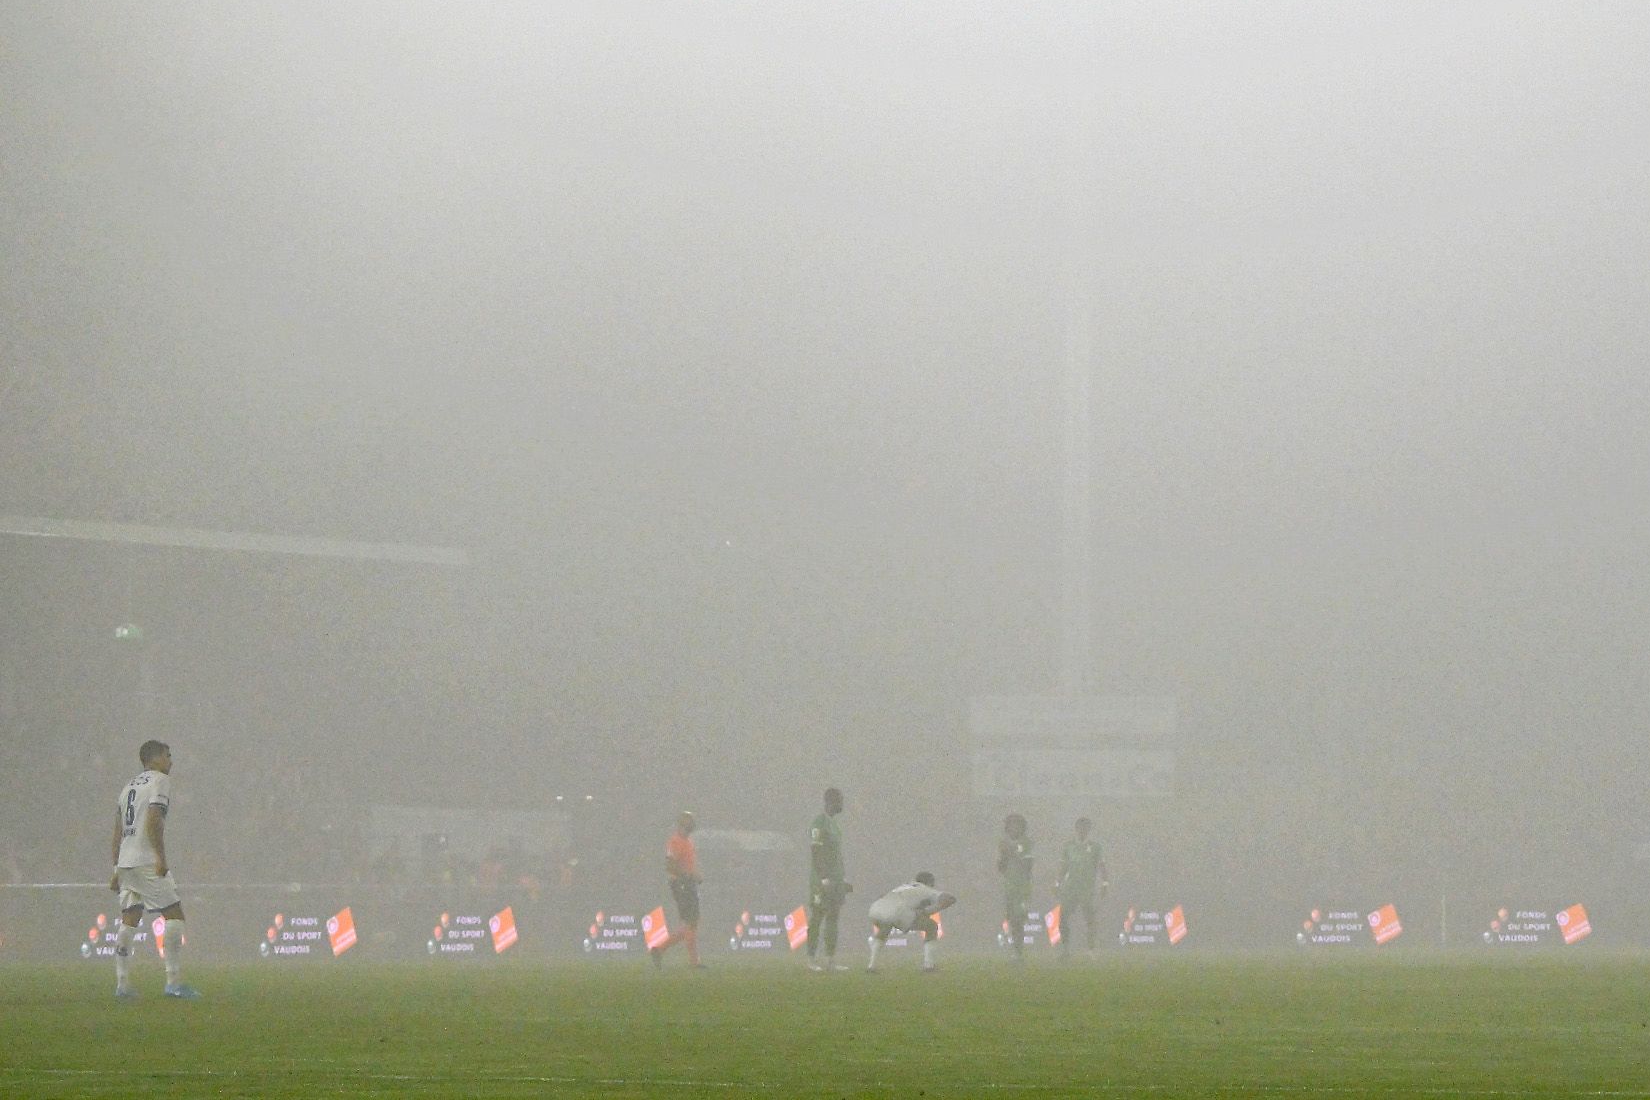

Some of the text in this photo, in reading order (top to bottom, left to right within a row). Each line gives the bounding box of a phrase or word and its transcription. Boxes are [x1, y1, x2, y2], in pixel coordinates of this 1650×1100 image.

[1516, 911, 1546, 919] FONDS
[1507, 923, 1520, 931] DU
[1311, 935, 1351, 943] VAUDOIS
[1498, 934, 1538, 942] VAUDOIS
